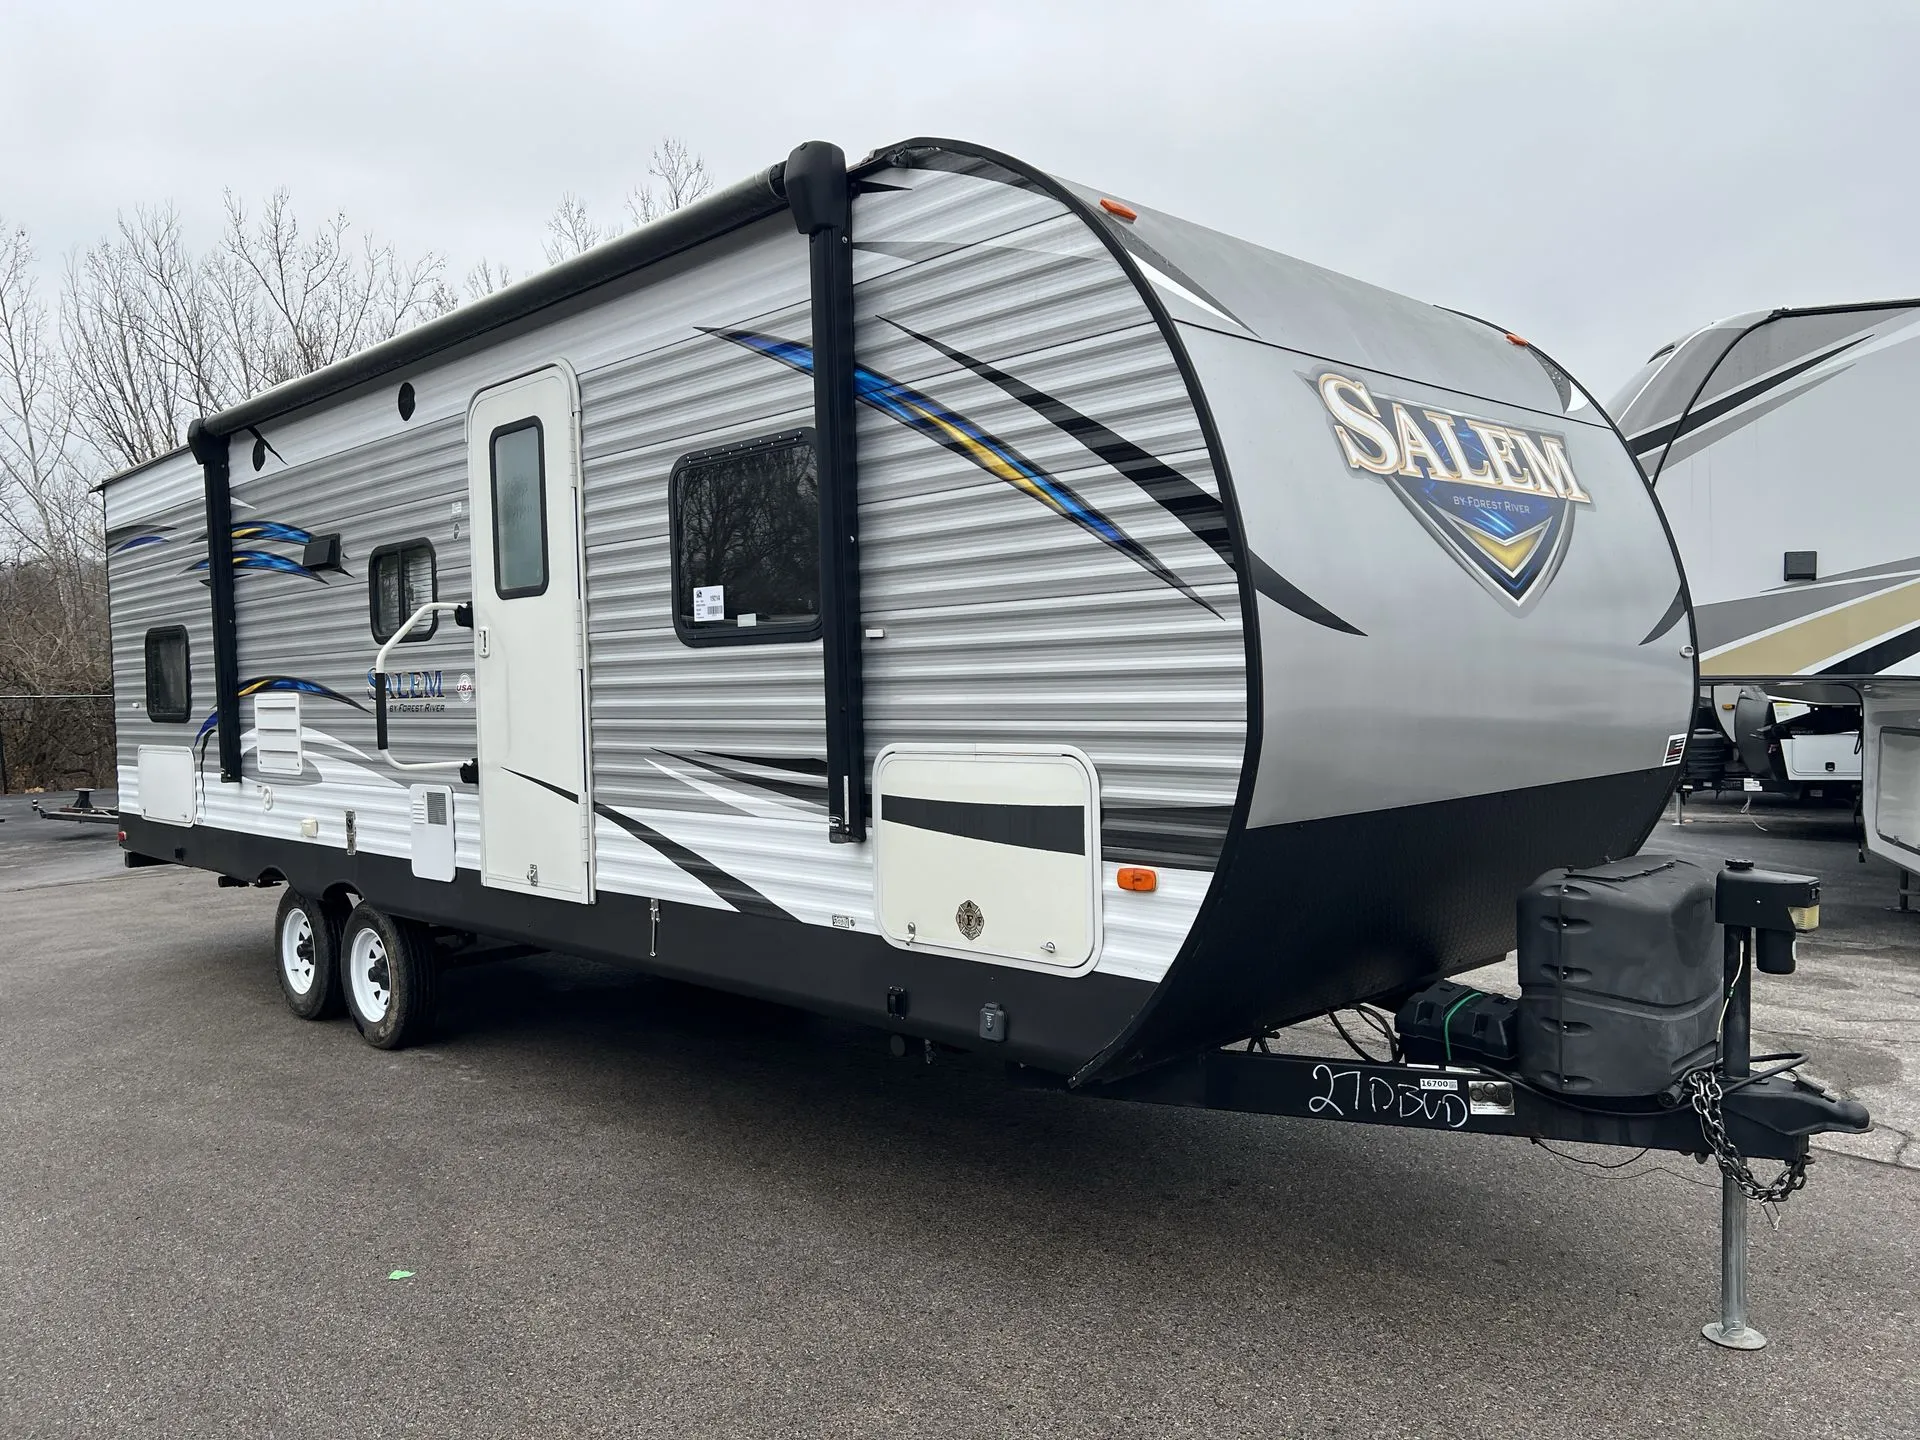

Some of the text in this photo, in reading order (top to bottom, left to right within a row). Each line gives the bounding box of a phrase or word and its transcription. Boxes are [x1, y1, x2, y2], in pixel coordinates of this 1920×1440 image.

[1318, 373, 1591, 503] SALEM
[1453, 496, 1531, 514] BY FOREST RIVER
[389, 703, 445, 713] BY FOREST RIVER
[1421, 1080, 1449, 1088] 16700
